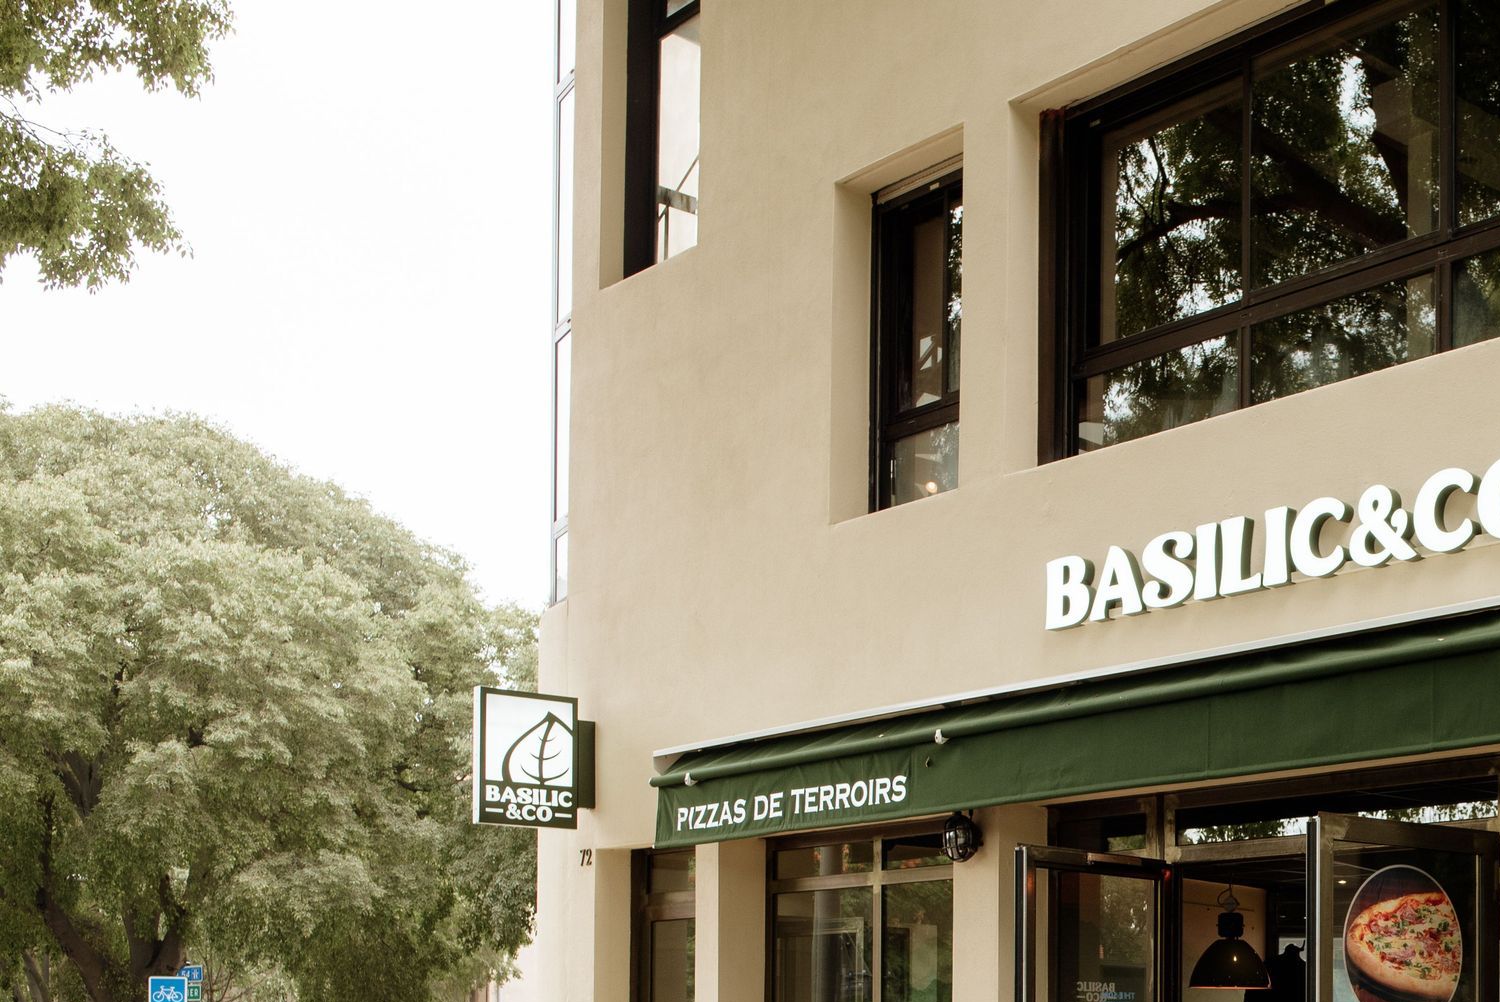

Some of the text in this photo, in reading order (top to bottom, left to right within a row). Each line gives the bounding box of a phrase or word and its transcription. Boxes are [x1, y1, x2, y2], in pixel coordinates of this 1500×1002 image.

[485, 784, 573, 808] BASILIC
[677, 775, 908, 831] PIZZAS DE TERROIRS
[505, 804, 553, 822] &CO
[579, 848, 593, 867] 72
